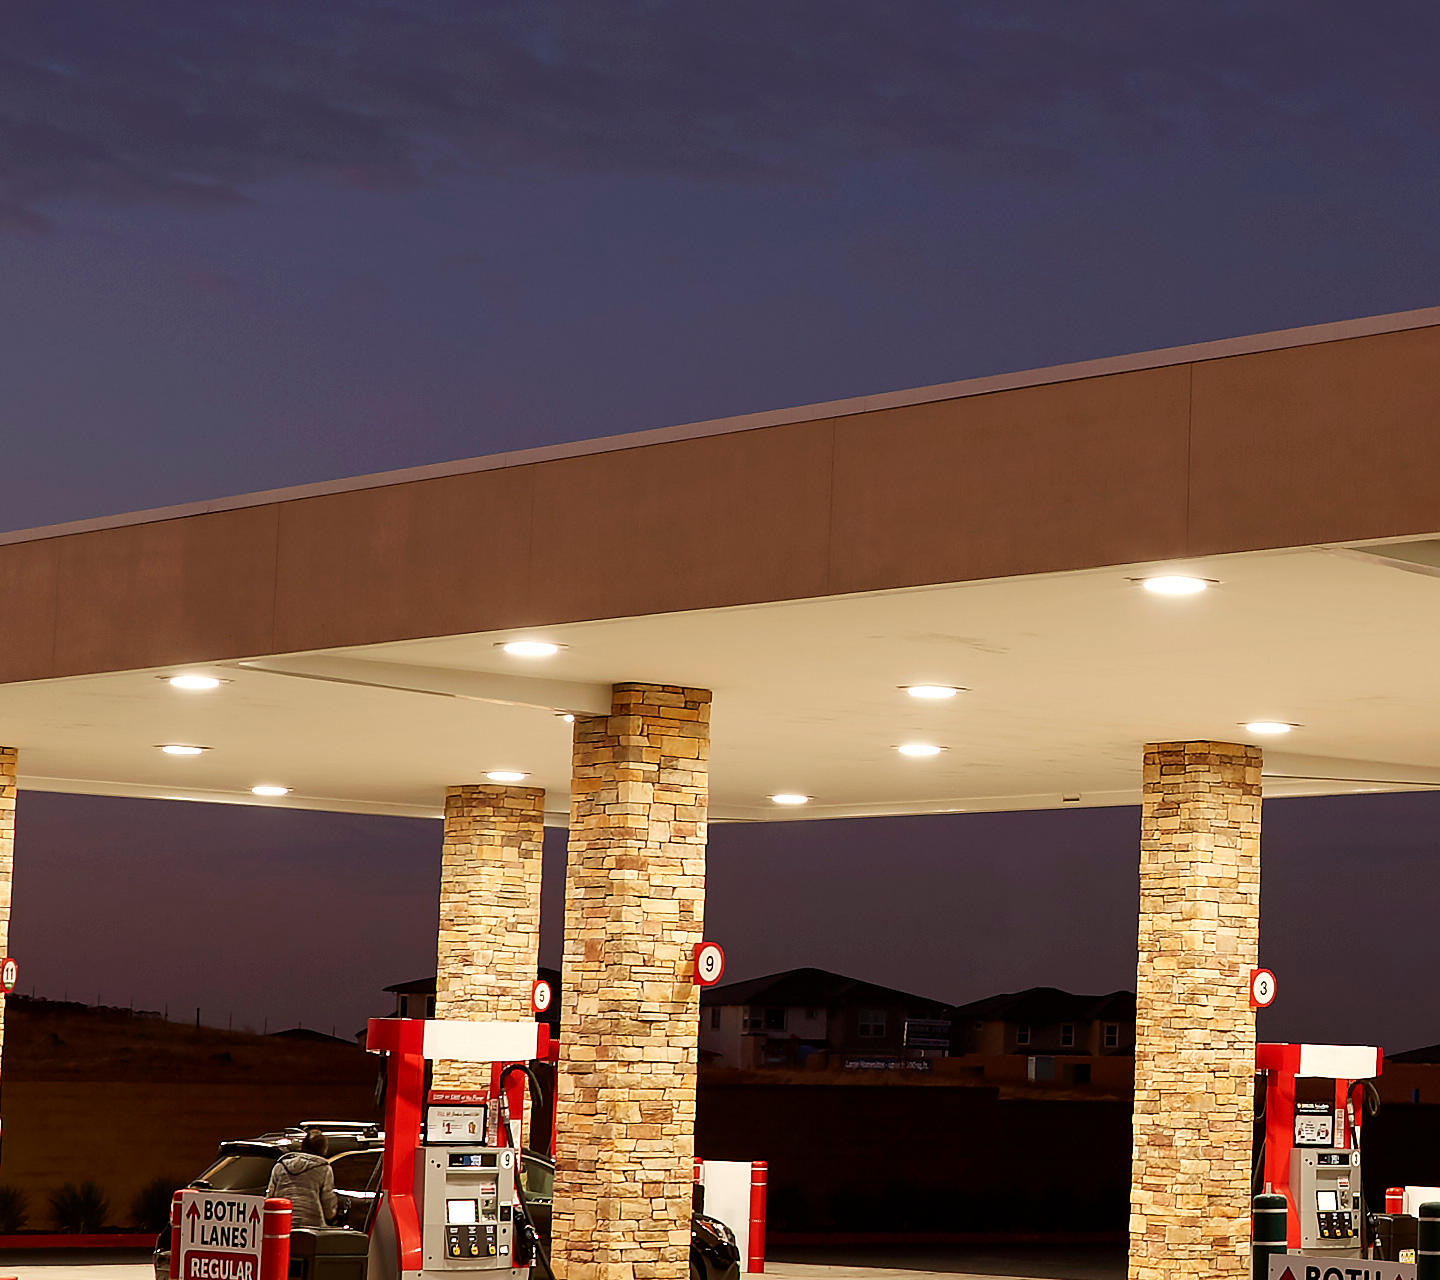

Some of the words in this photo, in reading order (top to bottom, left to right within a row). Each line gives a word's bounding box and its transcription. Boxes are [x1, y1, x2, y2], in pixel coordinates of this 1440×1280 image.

[705, 955, 714, 972] 9
[6, 967, 14, 980] 11
[1260, 981, 1267, 995] 3
[539, 990, 545, 1002] 5
[203, 1200, 247, 1223] BOTH
[200, 1225, 248, 1248] LANES
